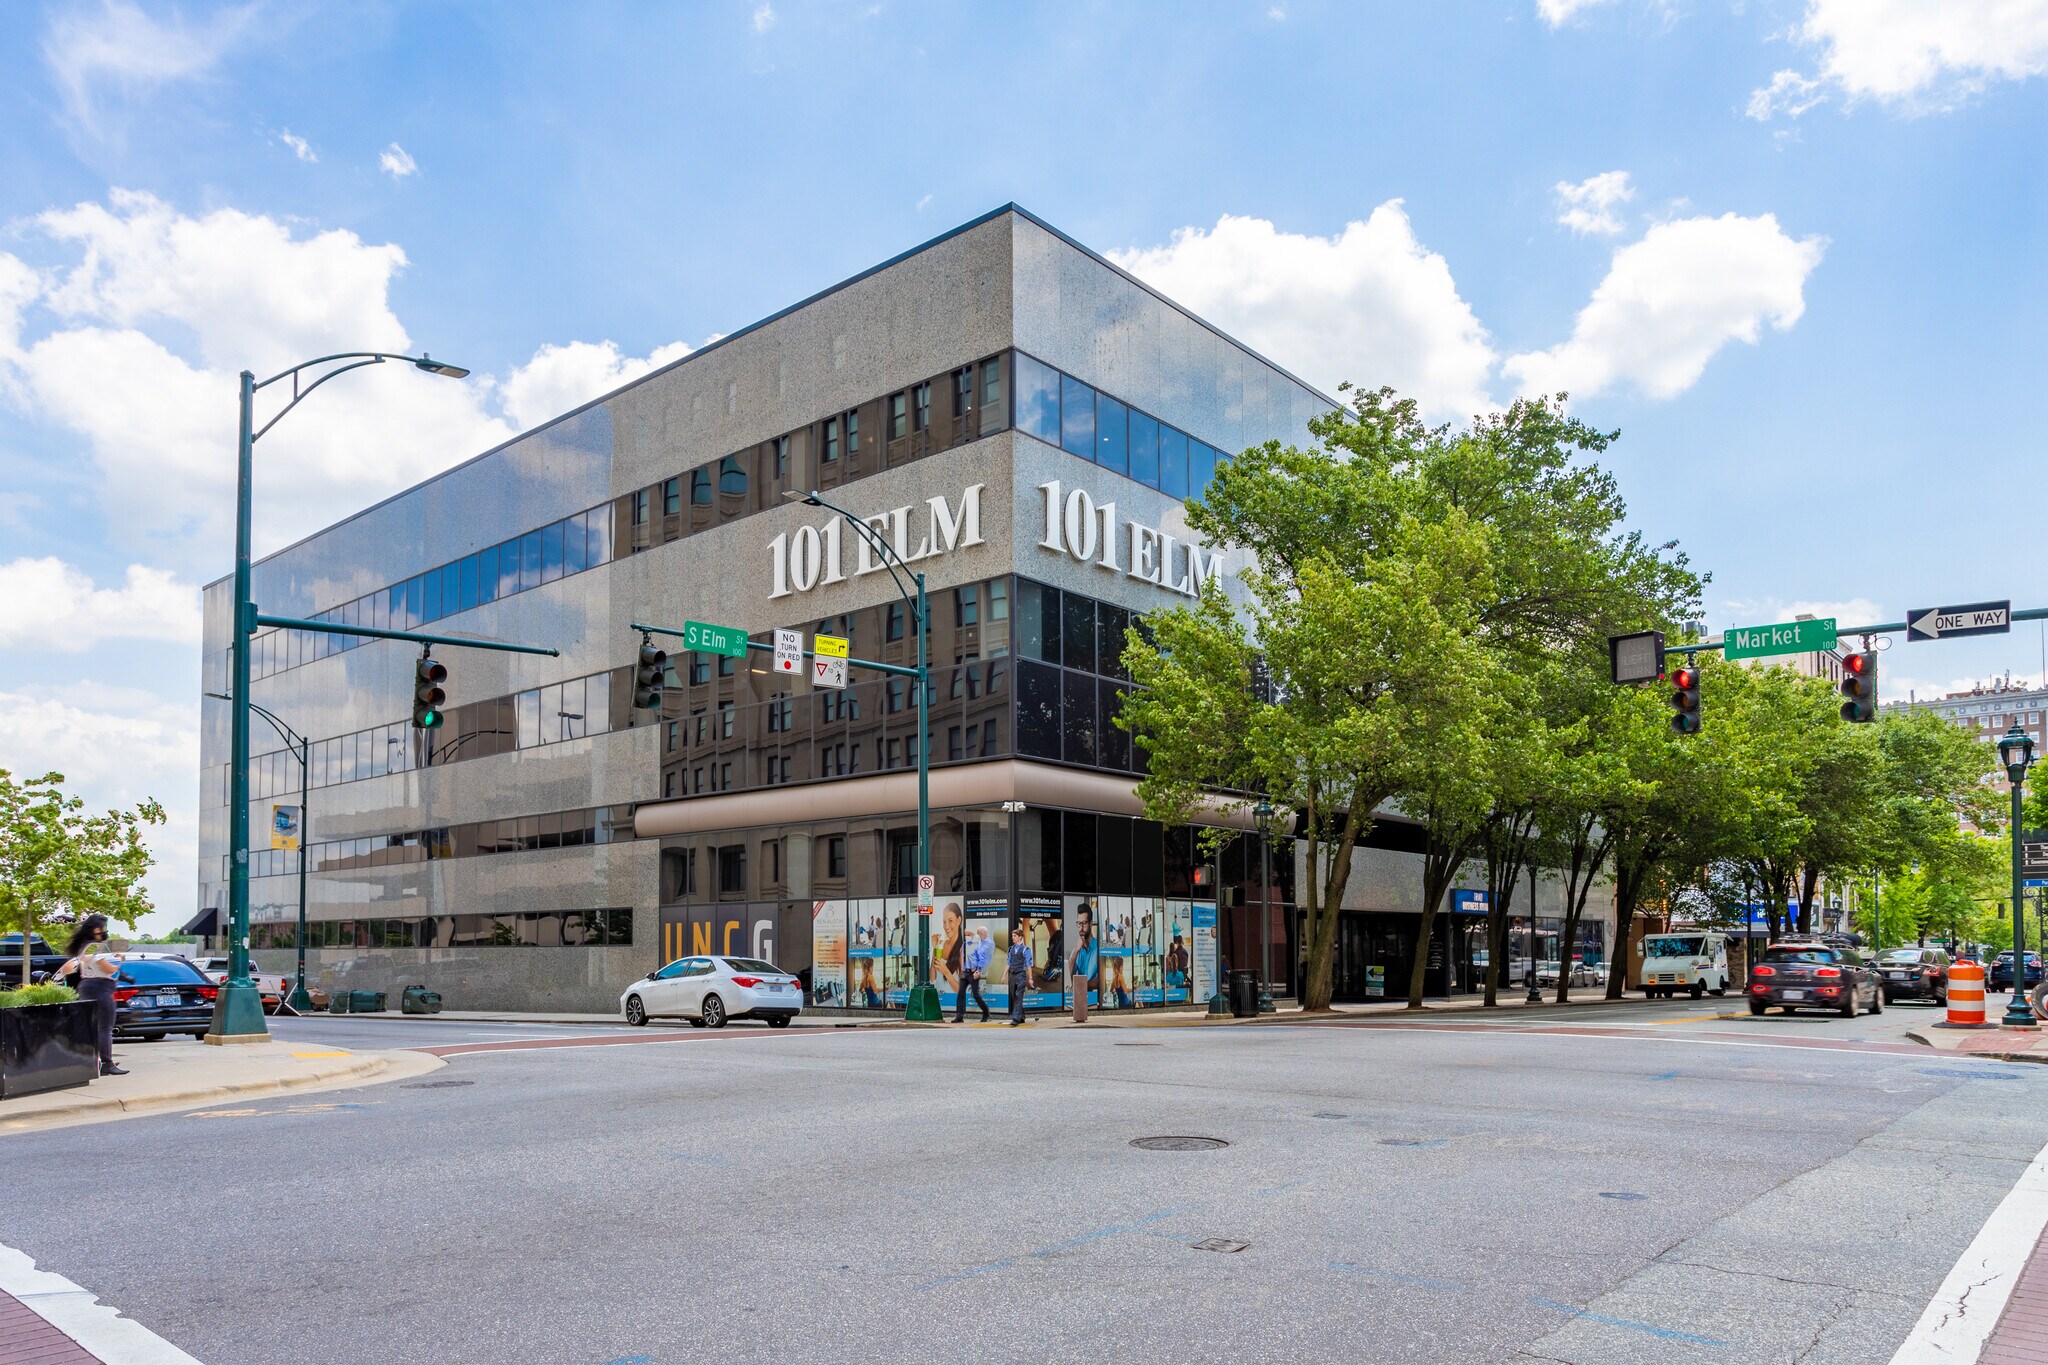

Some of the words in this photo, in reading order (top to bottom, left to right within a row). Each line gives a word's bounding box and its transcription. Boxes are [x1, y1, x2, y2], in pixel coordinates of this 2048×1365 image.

[767, 515, 847, 599] 101
[854, 483, 985, 576] ELM
[1038, 480, 1122, 572] 101
[1127, 521, 1225, 598] ELM
[1935, 615, 1963, 629] ONE
[1973, 611, 2003, 626] WAY
[689, 627, 697, 643] S
[702, 629, 726, 649] Elm
[736, 635, 743, 645] St
[783, 633, 795, 642] NO
[1725, 632, 1731, 642] E
[1736, 625, 1801, 649] Market
[1823, 620, 1834, 631] St
[781, 643, 797, 652] TURN
[817, 646, 837, 655] VEHICLES
[1626, 639, 1647, 651] NO
[1822, 641, 1835, 650] 100
[733, 648, 741, 656] 100
[788, 653, 800, 661] RED
[665, 920, 773, 966] UNCG
